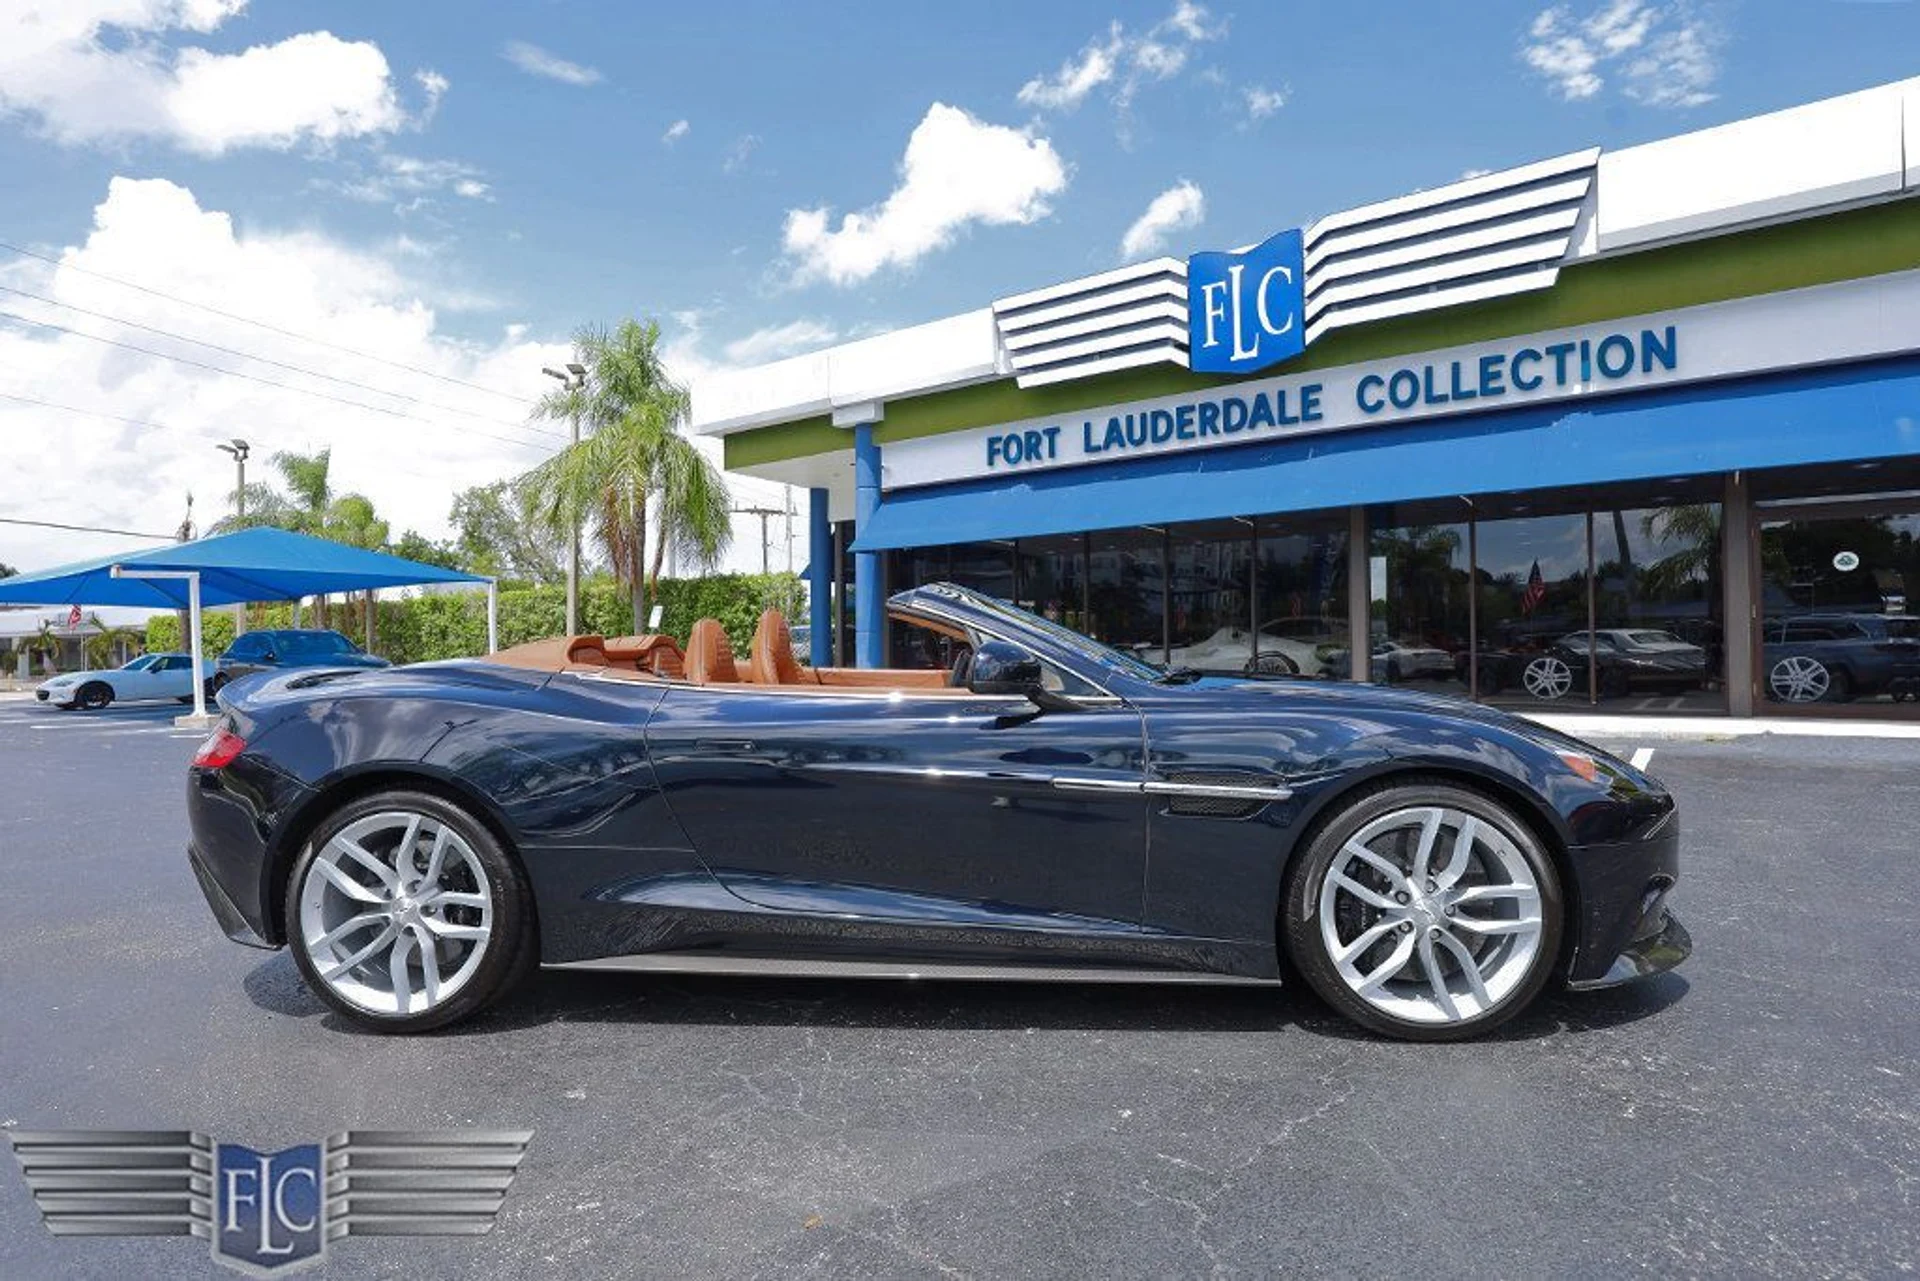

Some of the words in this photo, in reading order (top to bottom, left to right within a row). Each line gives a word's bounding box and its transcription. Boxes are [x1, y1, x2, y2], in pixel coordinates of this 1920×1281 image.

[1202, 264, 1294, 362] FLC
[986, 426, 1060, 466] FORT
[1083, 384, 1323, 454] LAUDERDALE
[1355, 326, 1677, 415] COLLECTION
